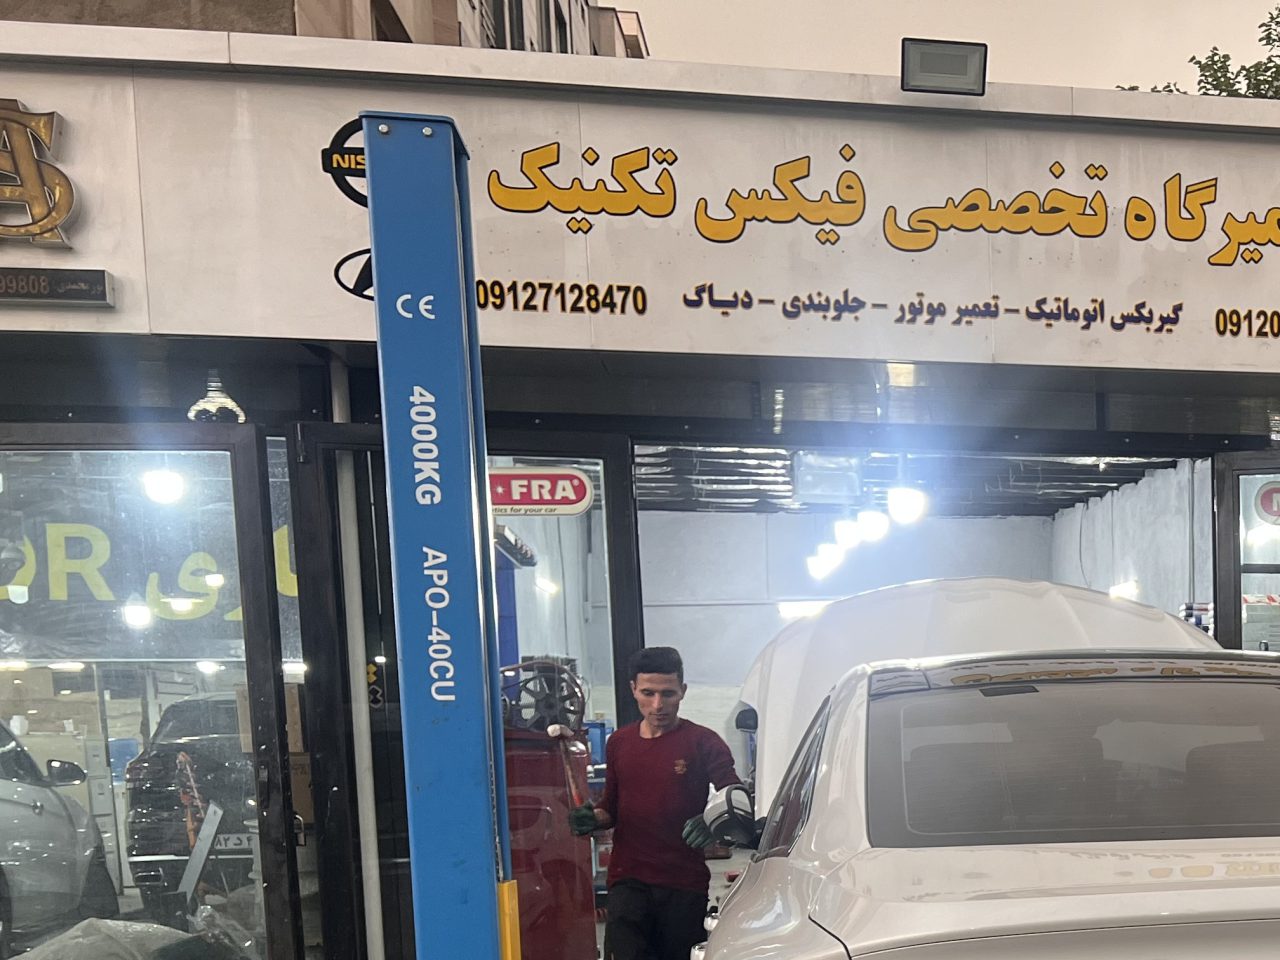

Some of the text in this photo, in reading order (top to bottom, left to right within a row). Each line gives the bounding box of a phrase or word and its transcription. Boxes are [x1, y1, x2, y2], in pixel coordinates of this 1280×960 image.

[487, 141, 679, 235] تکنیک
[694, 143, 866, 245] فیکس
[882, 161, 1108, 252] تخصصی
[395, 293, 436, 320] CE
[475, 279, 648, 315] 09127128470
[682, 282, 1184, 335] گیربکس اتوماتیک تعمیر موتور جلوبندی دیاگ
[409, 385, 456, 702] 4000KG APO-40CU
